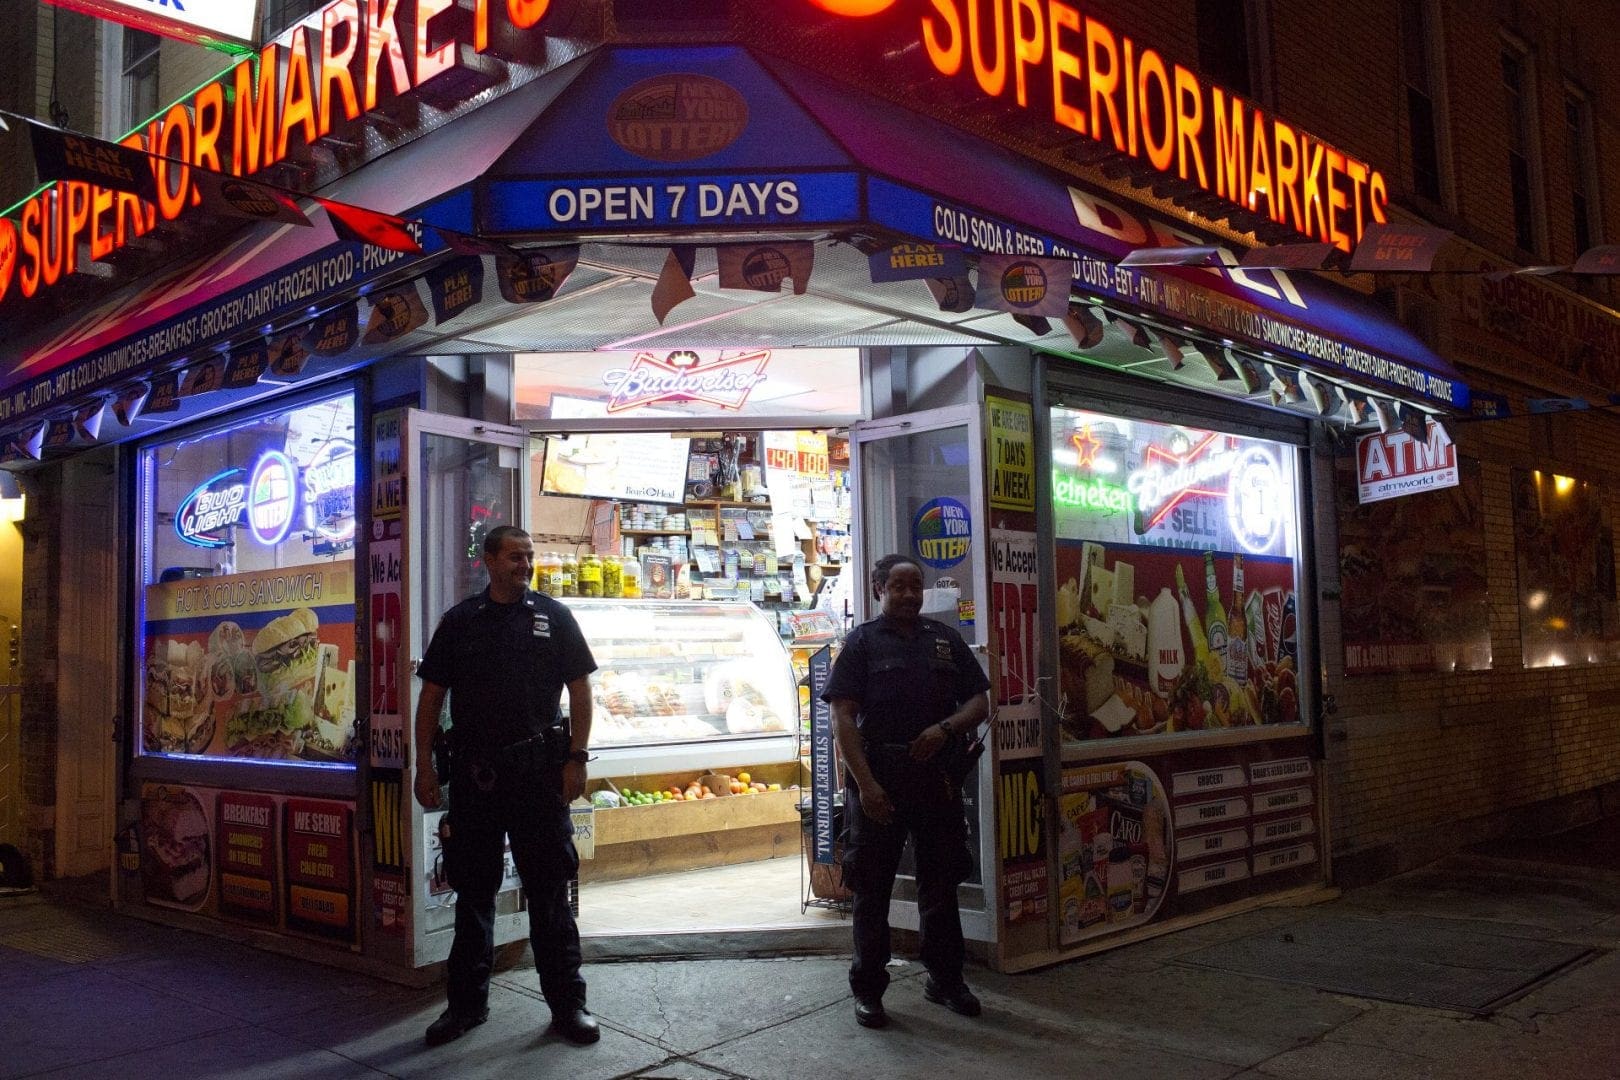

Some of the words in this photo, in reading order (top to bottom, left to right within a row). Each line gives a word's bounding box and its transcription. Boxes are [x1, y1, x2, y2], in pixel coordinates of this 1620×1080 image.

[920, 0, 1209, 190] SUPERIOR
[1212, 84, 1389, 254] MARKETS
[20, 82, 222, 298] SUPERIOR
[548, 187, 654, 222] OPEN
[666, 187, 687, 218] 7
[698, 181, 800, 217] DAYS
[935, 205, 969, 244] COLD
[971, 217, 1005, 254] SODA
[1006, 228, 1014, 255] &
[890, 253, 945, 269] HERE!
[1083, 254, 1109, 289] CUTS
[1114, 263, 1134, 297] EBT
[1240, 312, 1262, 340] COLD
[55, 373, 71, 398] HOT
[77, 360, 97, 387] COLD
[321, 250, 354, 291] FOOD
[602, 367, 768, 399] Budweiser
[996, 440, 1002, 464] 7
[1005, 440, 1027, 467] DAYS
[1363, 427, 1449, 483] ATM
[195, 483, 246, 516] BUD
[993, 471, 1001, 494] A
[1003, 470, 1031, 500] WEEK
[1378, 475, 1435, 493] atmworld
[184, 501, 247, 537] LIGHT
[942, 505, 964, 519] NEW
[944, 518, 970, 536] YORK
[917, 536, 972, 560] LOTTERY
[1005, 542, 1037, 581] Accept
[175, 585, 200, 613] HOT
[201, 585, 209, 610] &
[213, 581, 246, 610] COLD
[248, 573, 323, 606] SANDWICH
[991, 582, 1037, 707] EBT
[1159, 649, 1179, 665] MILK
[813, 662, 827, 690] THE
[815, 697, 829, 735] WALL
[815, 736, 829, 790] STREET
[1198, 774, 1224, 787] GROCERY
[223, 803, 270, 826] BREAKFAST
[293, 810, 310, 830] WE
[311, 812, 341, 835] SERVE
[1199, 804, 1226, 819] PRODUCE
